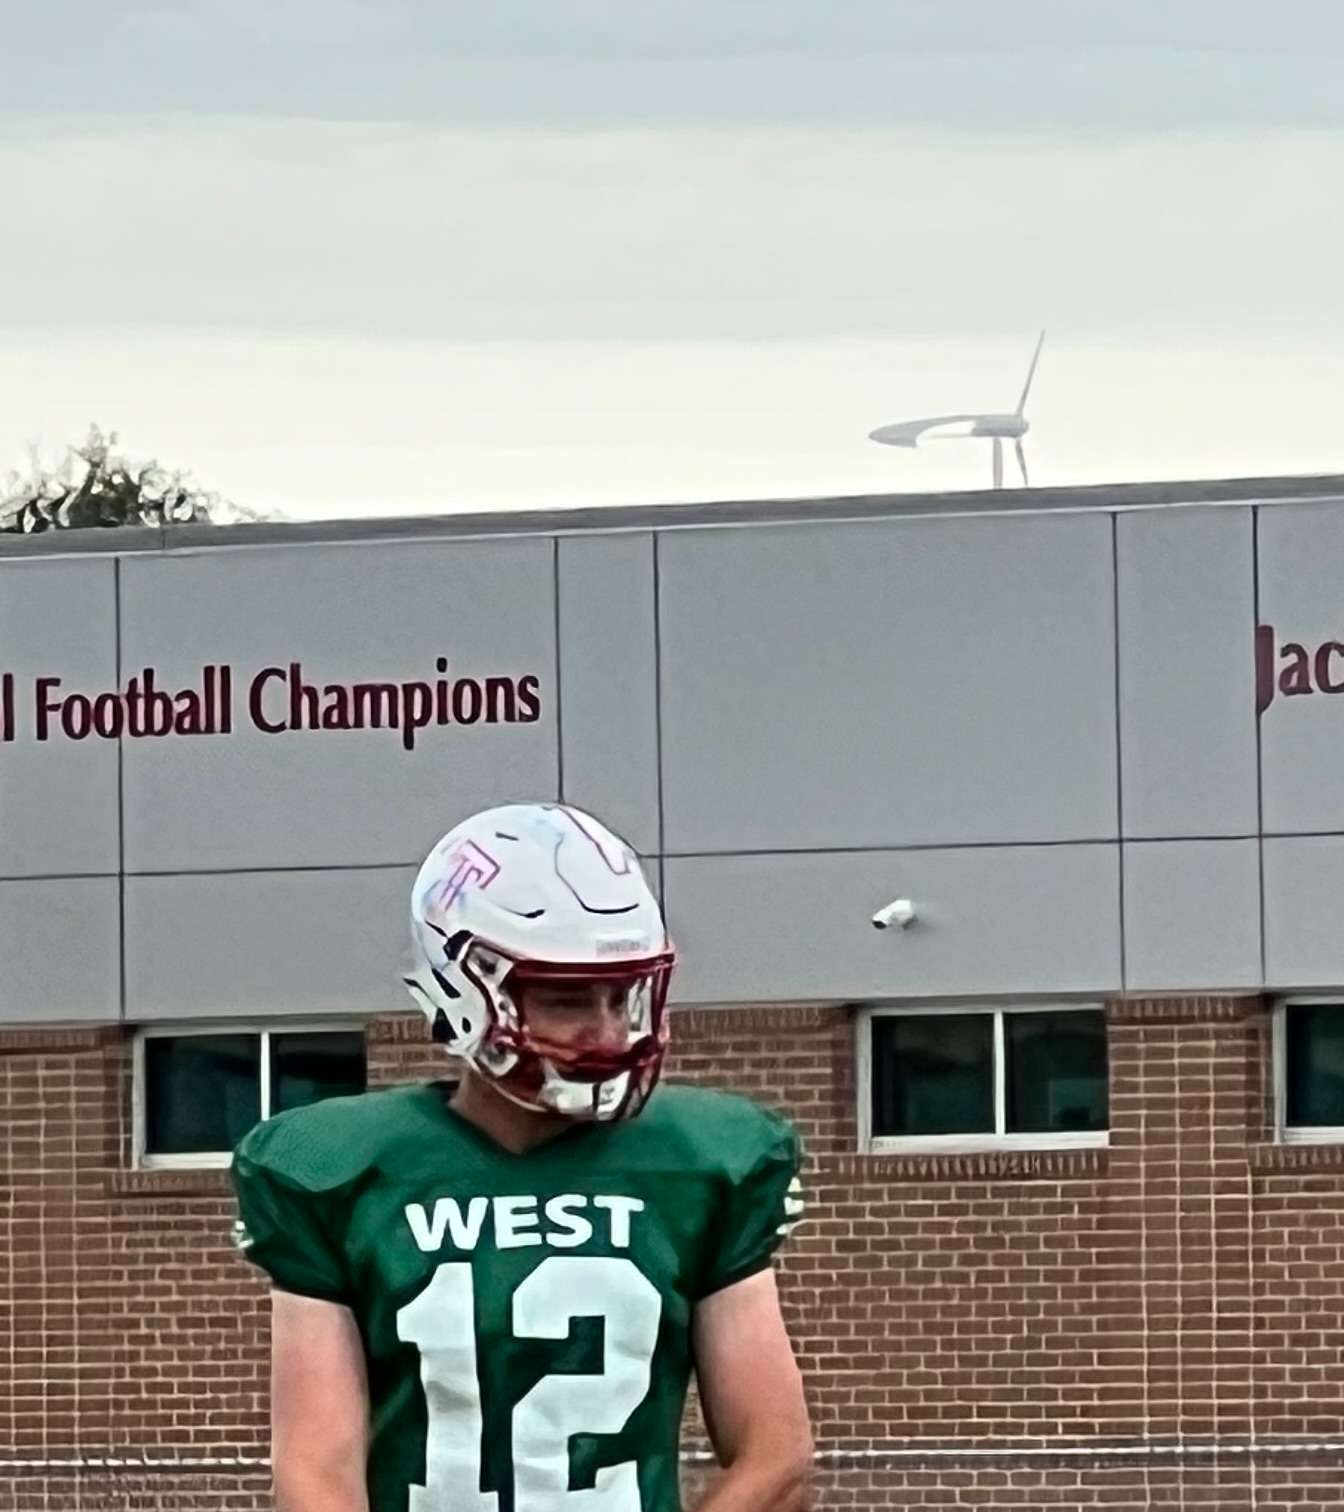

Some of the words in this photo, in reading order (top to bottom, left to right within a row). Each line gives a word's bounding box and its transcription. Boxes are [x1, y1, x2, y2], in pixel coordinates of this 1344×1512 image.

[35, 665, 233, 742] Football
[250, 657, 542, 749] Champions
[405, 1194, 645, 1251] WEST
